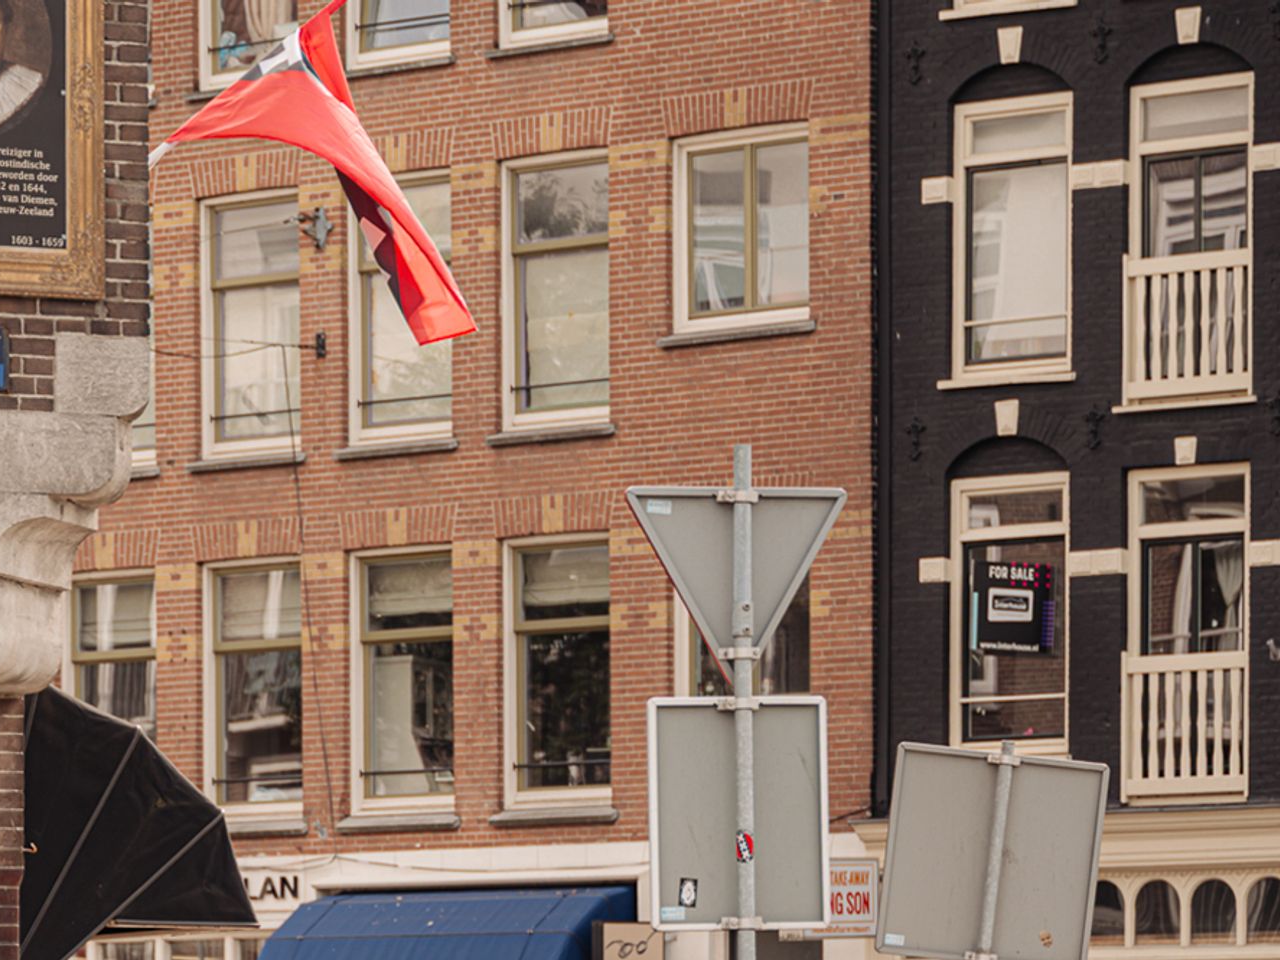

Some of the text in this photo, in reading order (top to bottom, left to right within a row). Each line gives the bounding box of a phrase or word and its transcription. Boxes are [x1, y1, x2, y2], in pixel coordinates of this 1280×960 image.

[34, 149, 43, 158] in
[37, 172, 58, 182] door
[8, 184, 20, 192] en
[2, 195, 19, 203] van
[21, 194, 58, 206] Diemen,
[11, 235, 33, 246] 1603
[42, 237, 64, 247] 1659
[988, 565, 1035, 581] FOR SALE
[830, 870, 870, 886] TAKE AWAY
[830, 891, 870, 915] NG SON
